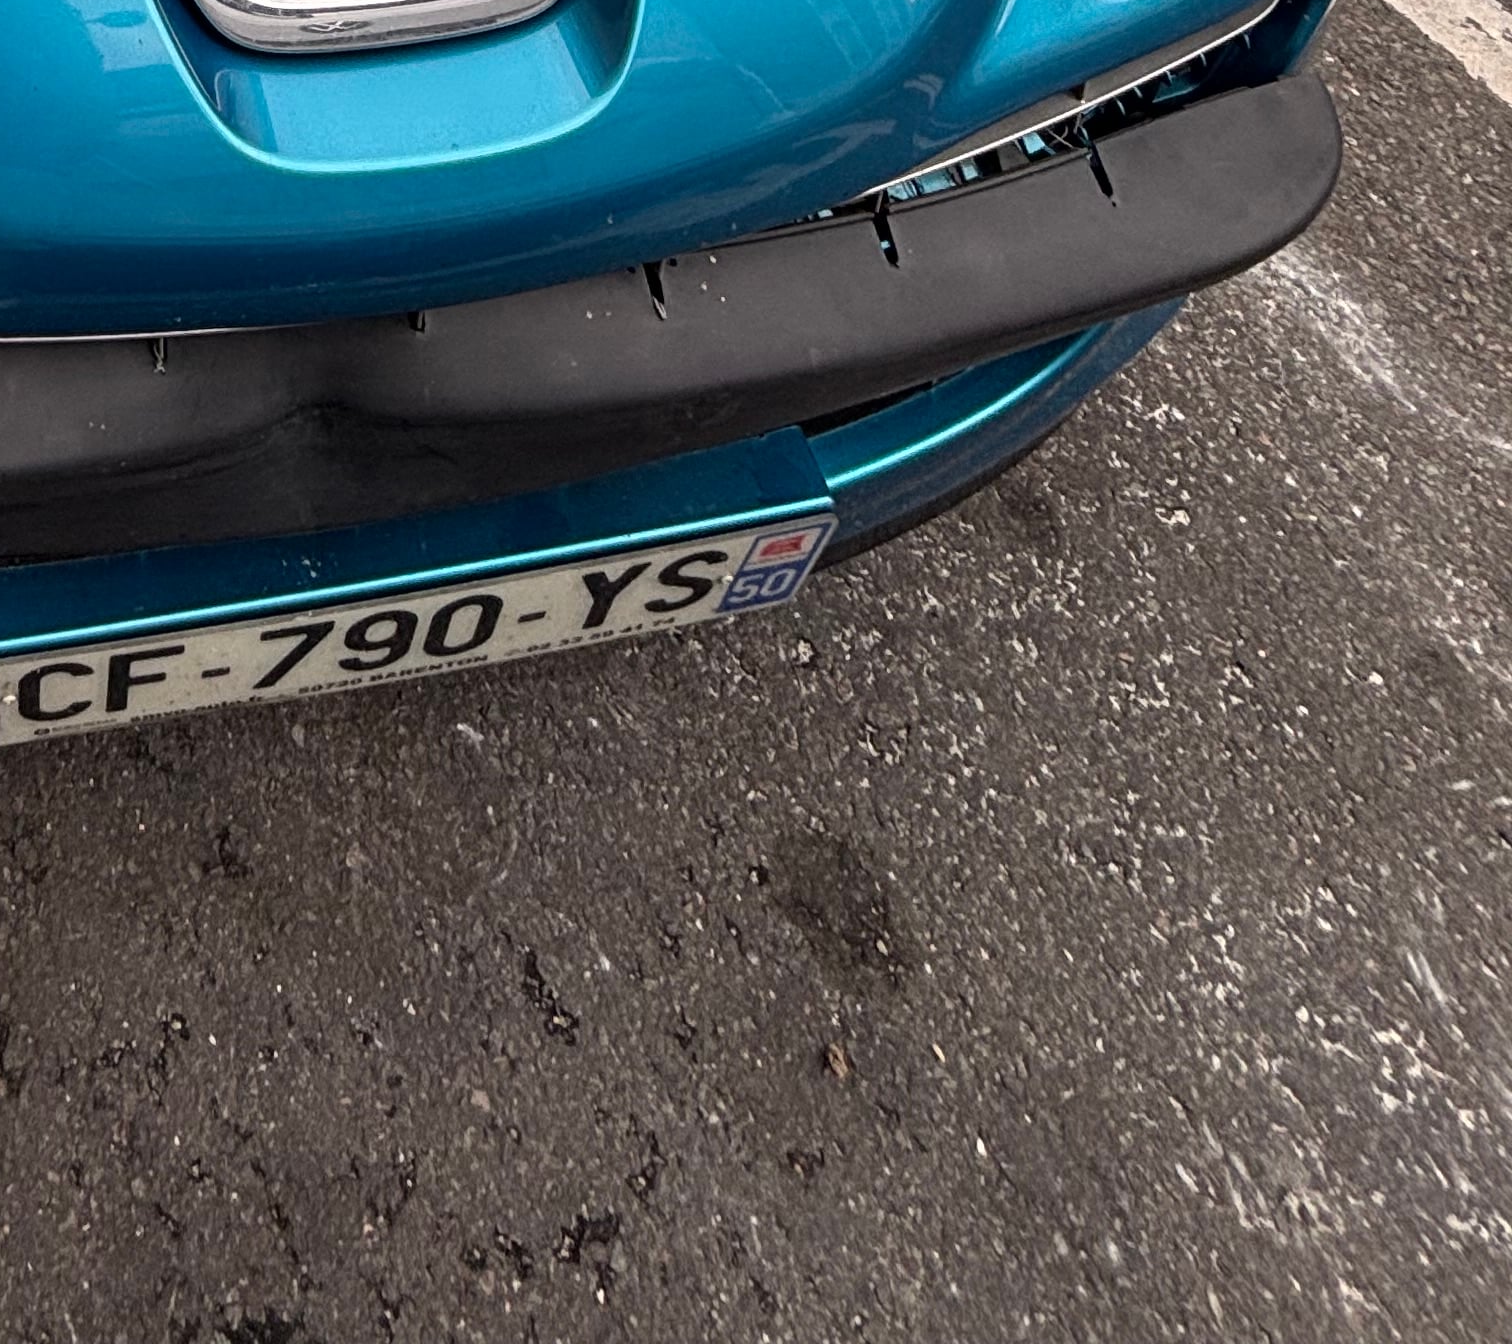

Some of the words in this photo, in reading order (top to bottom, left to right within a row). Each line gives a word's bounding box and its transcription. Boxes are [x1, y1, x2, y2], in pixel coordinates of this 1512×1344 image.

[729, 568, 796, 602] 50
[18, 551, 728, 720] CF-790-YS
[370, 655, 488, 681] BARENTON
